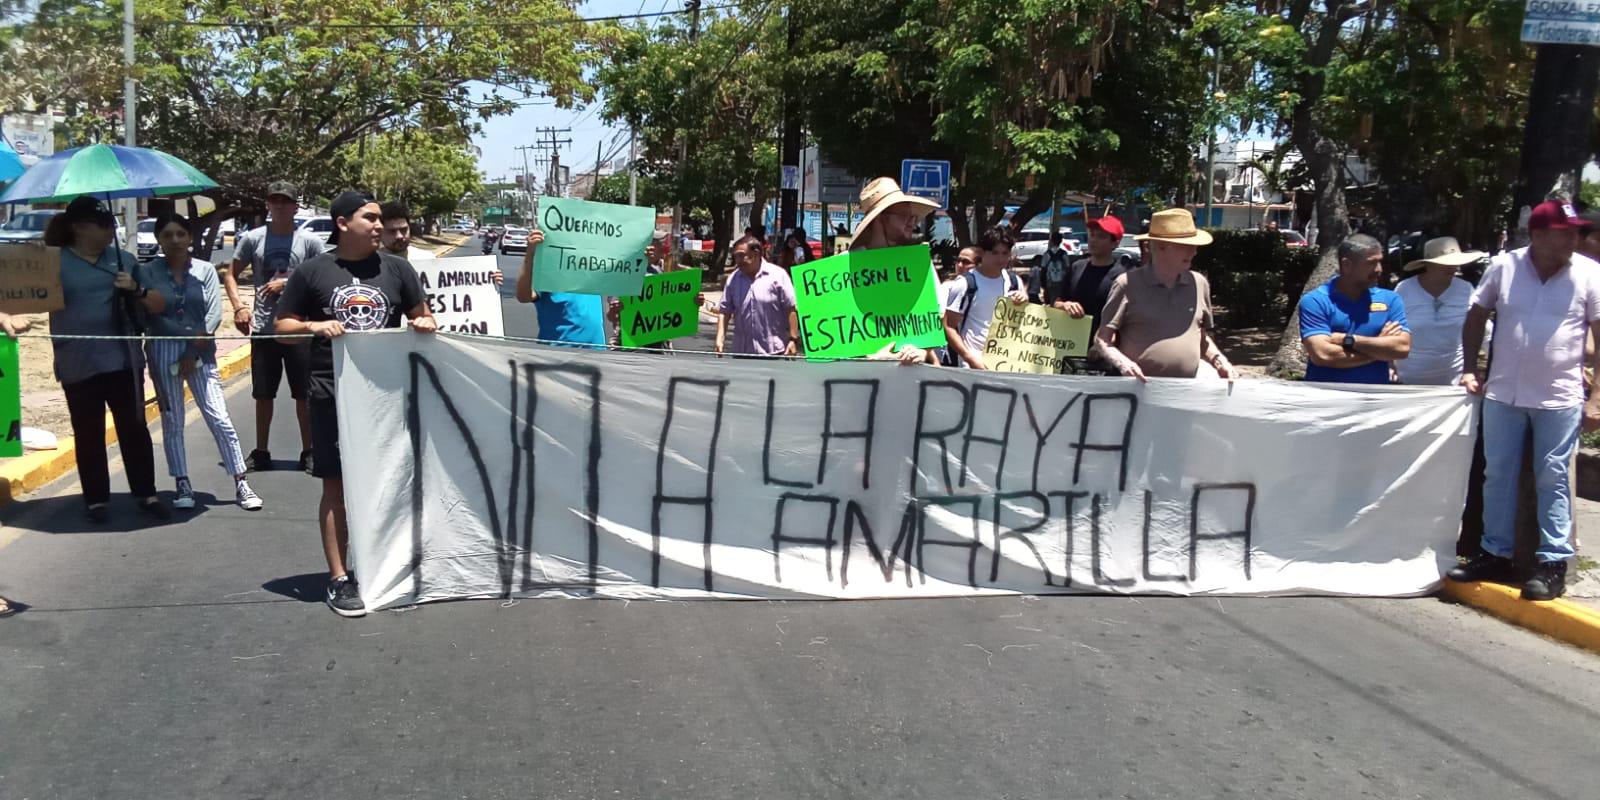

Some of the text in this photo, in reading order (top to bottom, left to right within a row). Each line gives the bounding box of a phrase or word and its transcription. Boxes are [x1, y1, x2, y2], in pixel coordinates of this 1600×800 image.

[544, 205, 623, 238] QUEREMOS
[549, 245, 643, 274] TRABAJAR!
[438, 270, 496, 288] AMARILLA
[661, 281, 691, 296] HUBO
[803, 268, 888, 296] REGRESEN
[896, 267, 911, 283] EL
[427, 294, 472, 313] ES LA
[995, 299, 1050, 329] QUEREMOS
[631, 310, 682, 336] AVISO
[802, 311, 943, 352] ESTACIONAMIENTO
[996, 322, 1075, 350] ESTACIONAMIENTO
[986, 339, 1009, 357] PARA
[762, 379, 1138, 496] LA RAYA
[408, 352, 730, 598] NO A
[771, 482, 1256, 590] AMARILLA
